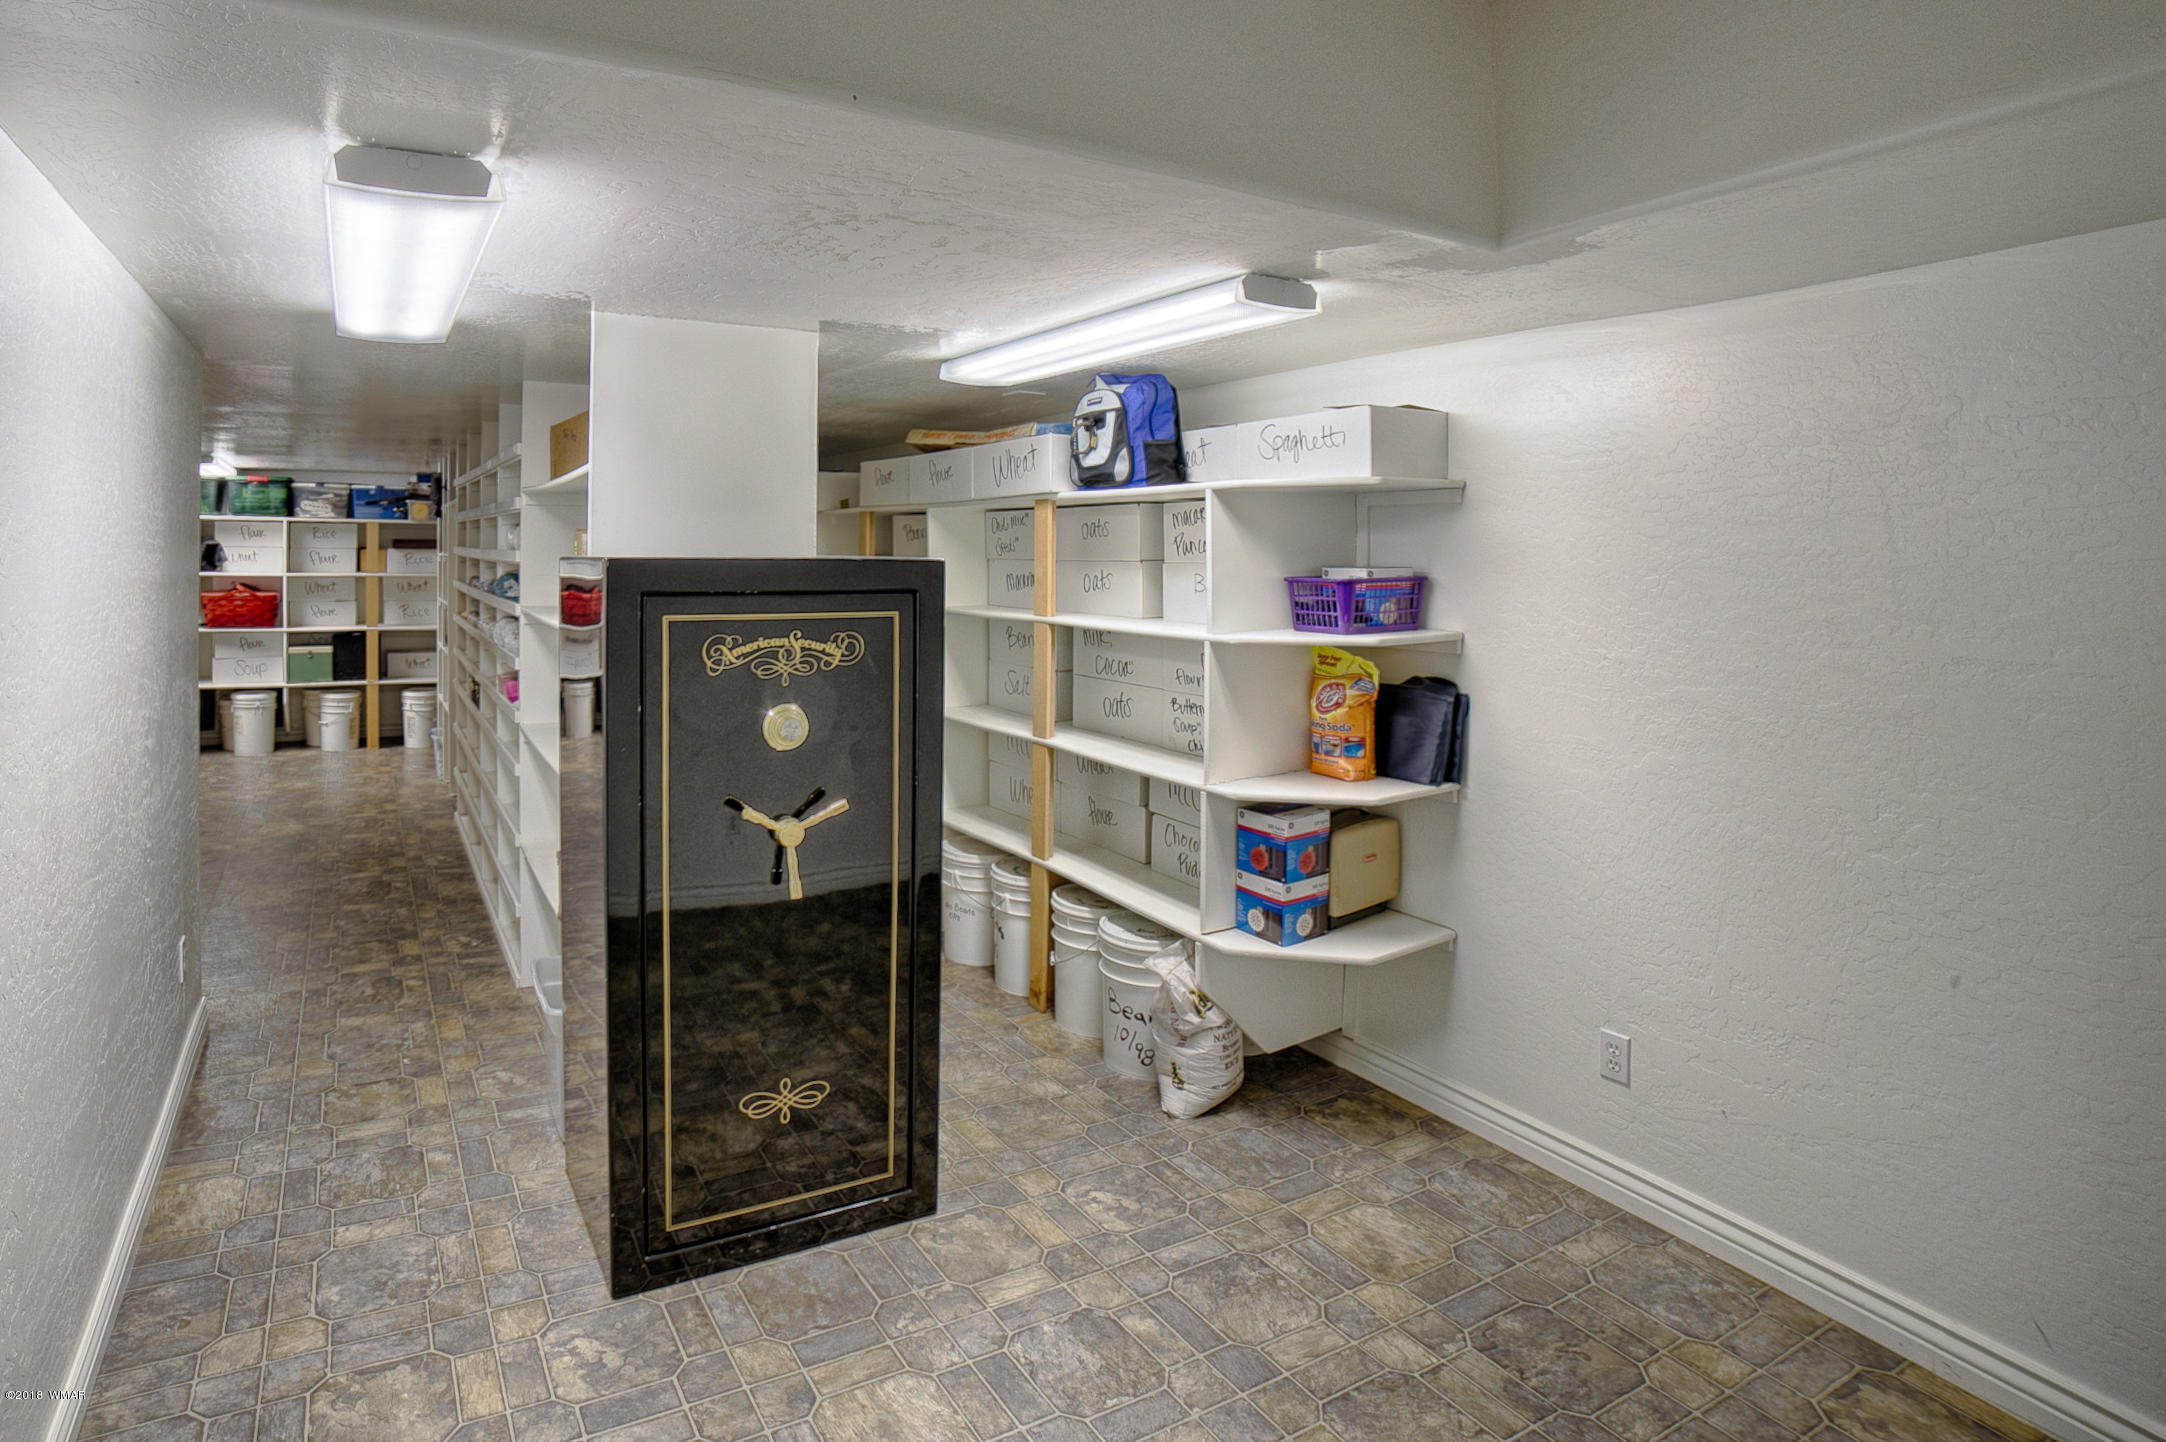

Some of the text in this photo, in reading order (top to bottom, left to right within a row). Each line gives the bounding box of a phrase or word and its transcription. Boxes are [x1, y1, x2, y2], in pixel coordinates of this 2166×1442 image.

[1258, 424, 1346, 463] Spaghetti
[992, 443, 1038, 488] Wheat
[313, 527, 337, 539] Rice
[404, 553, 433, 565] Rice
[304, 581, 337, 595] Wheat
[400, 604, 430, 618] Rice
[704, 630, 851, 669] American Security
[233, 659, 268, 678] Soup
[1327, 722, 1352, 732] Soda
[1113, 1024, 1156, 1067] 10/98
